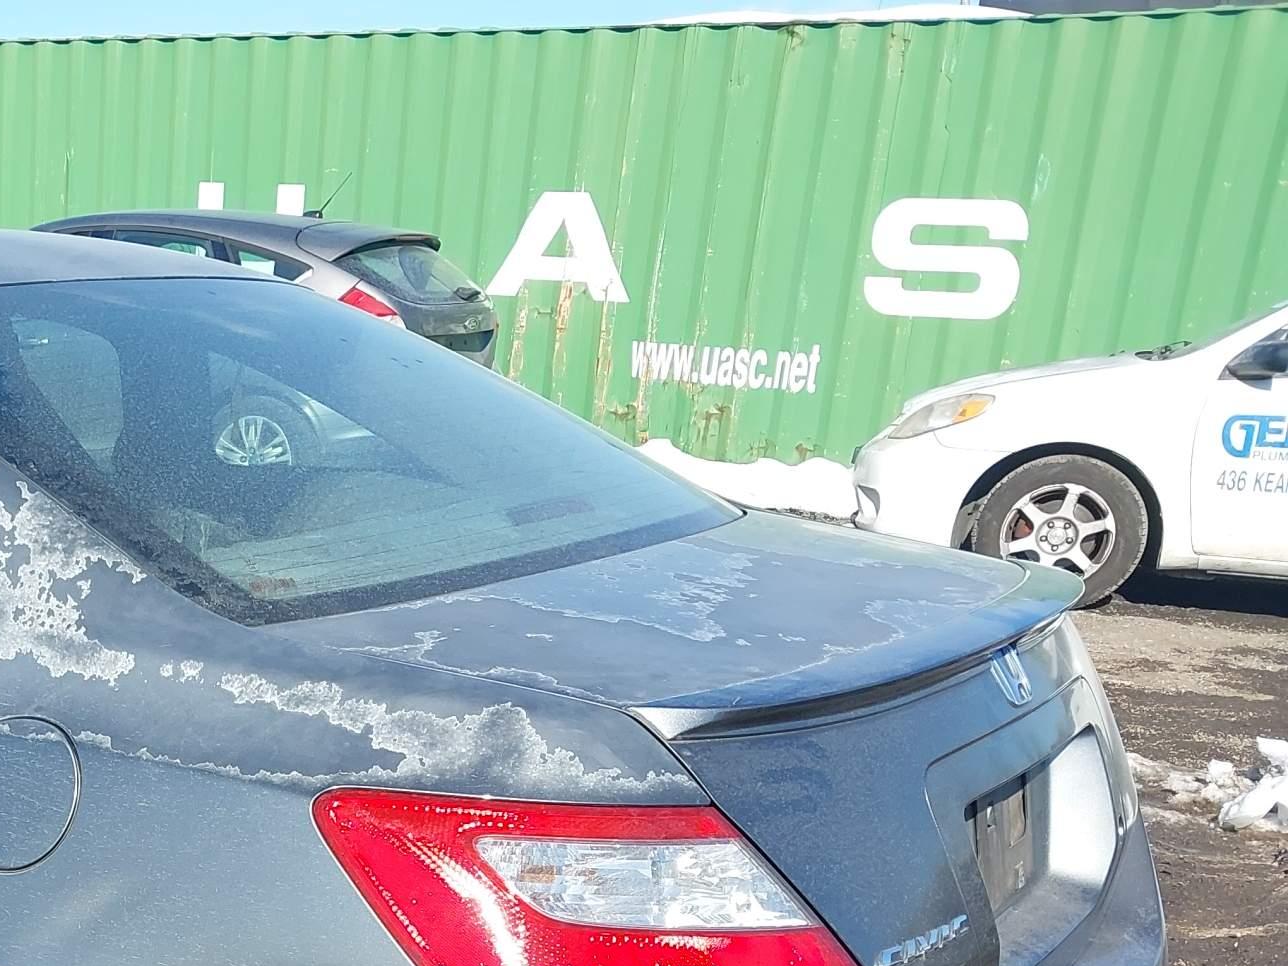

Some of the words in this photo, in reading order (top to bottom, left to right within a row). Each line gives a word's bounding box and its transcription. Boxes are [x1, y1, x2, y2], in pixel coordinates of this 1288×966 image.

[632, 340, 821, 394] www.uasc.net
[1222, 414, 1288, 458] GE
[1216, 470, 1248, 491] 436
[1253, 471, 1288, 493] KEA
